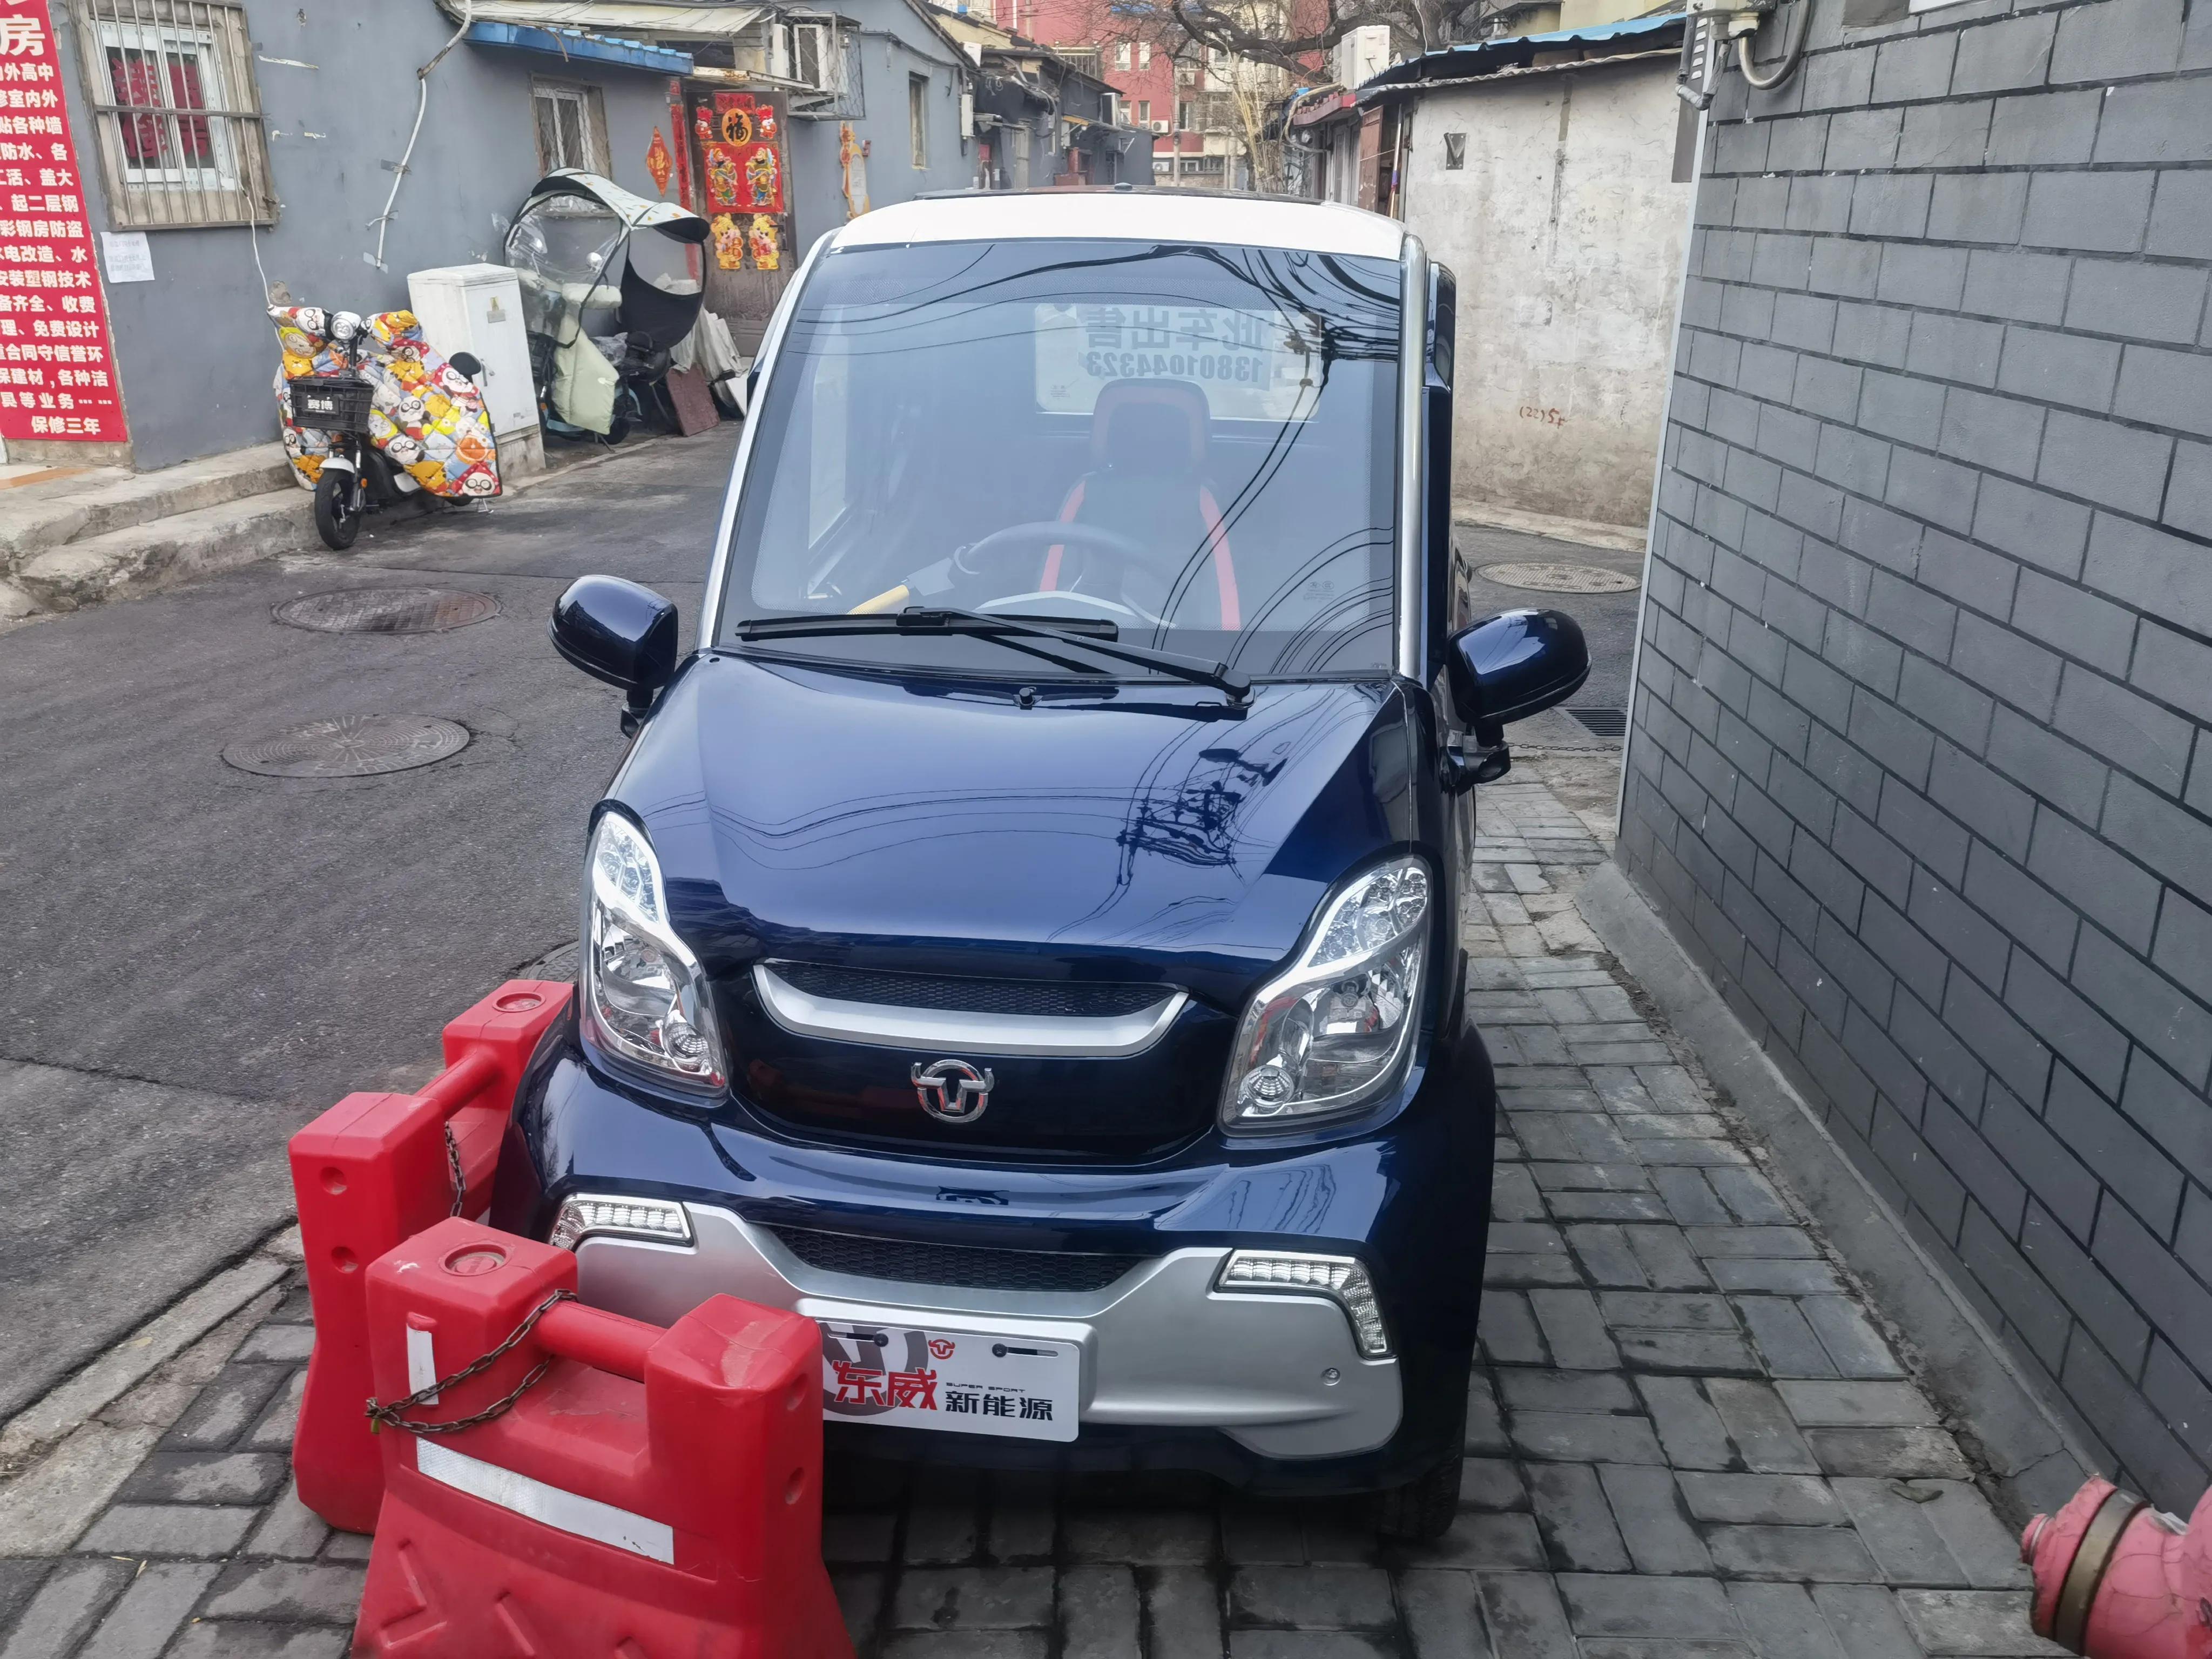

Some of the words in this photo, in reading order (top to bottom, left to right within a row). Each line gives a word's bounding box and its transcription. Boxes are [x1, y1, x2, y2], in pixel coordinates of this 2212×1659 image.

[0, 14, 45, 56] 房
[0, 62, 54, 82] 外高中
[726, 112, 748, 142] 福
[0, 219, 84, 238] 彩钢房防盗
[31, 415, 102, 435] 保修三年
[832, 1360, 938, 1411] 东威
[945, 1391, 1053, 1421] 新能源
